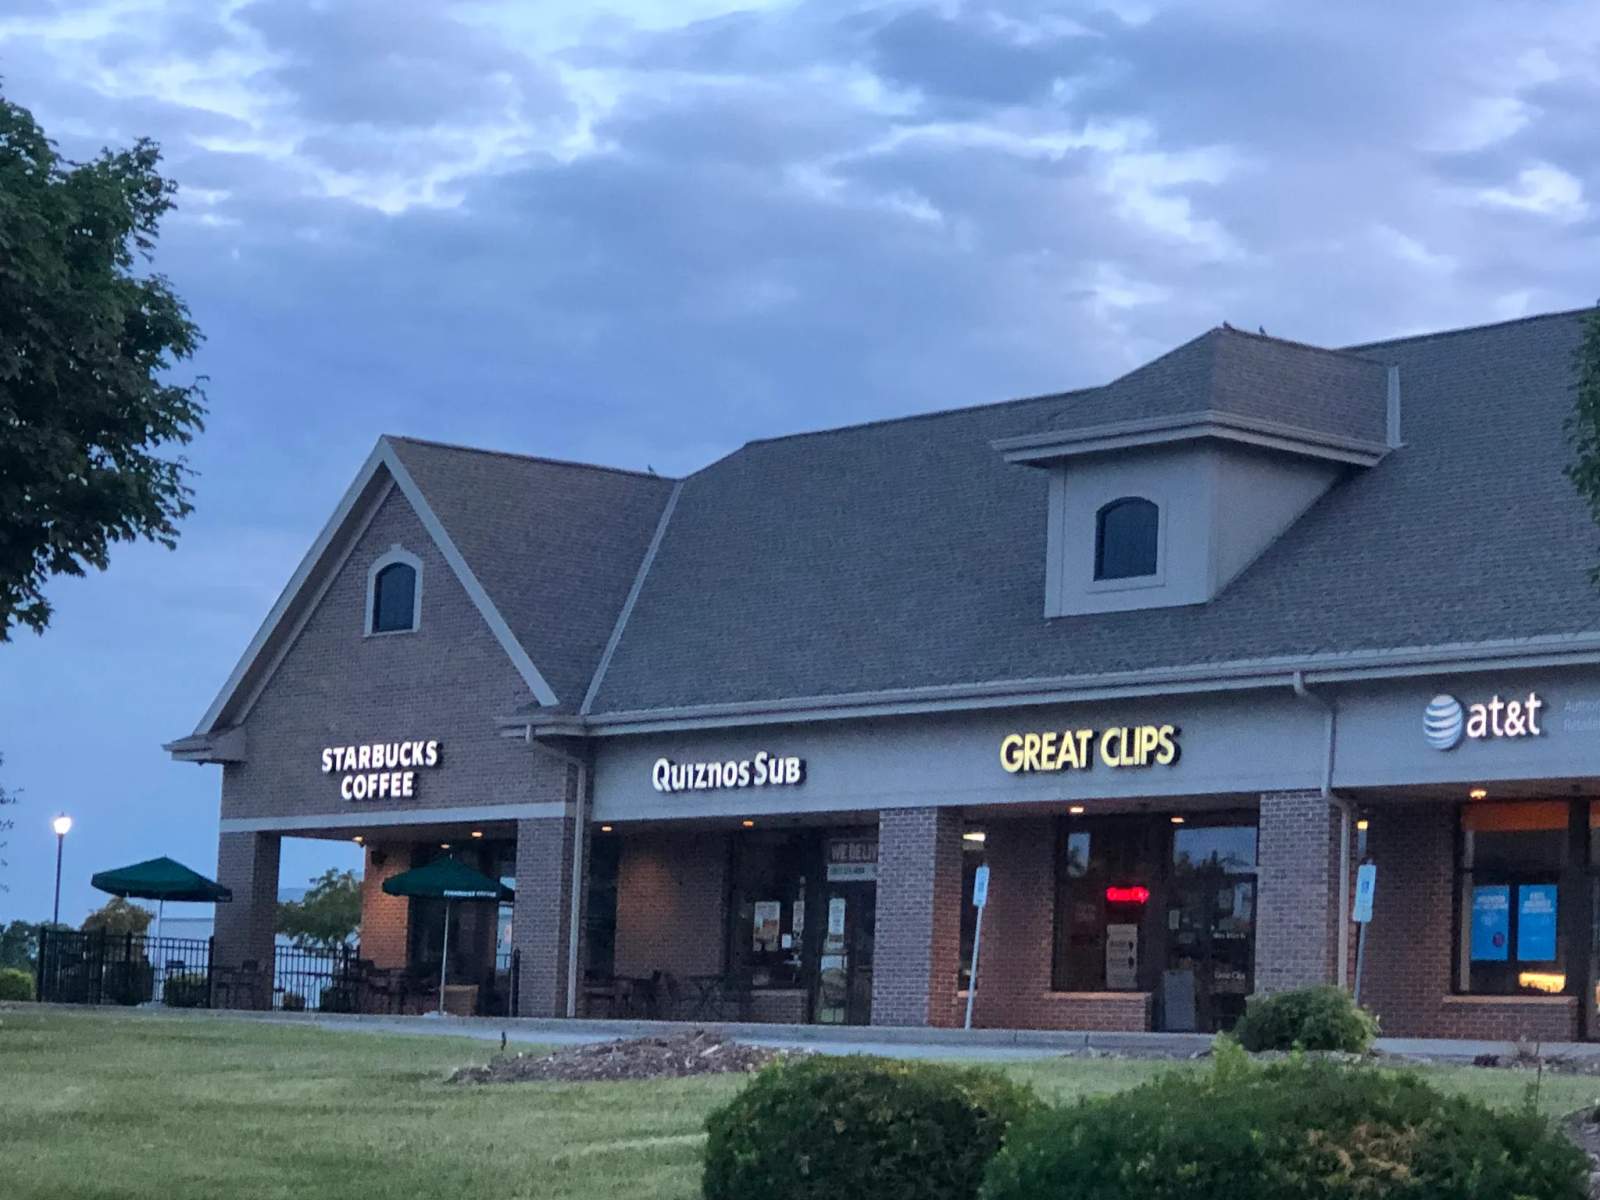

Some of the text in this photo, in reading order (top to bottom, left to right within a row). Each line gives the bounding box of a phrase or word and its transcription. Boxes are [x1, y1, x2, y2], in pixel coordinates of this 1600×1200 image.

[1466, 692, 1542, 738] at&t
[321, 740, 438, 772] STARBUCKS
[1000, 725, 1175, 773] GREAT CLIPS
[341, 771, 414, 800] COFFEE
